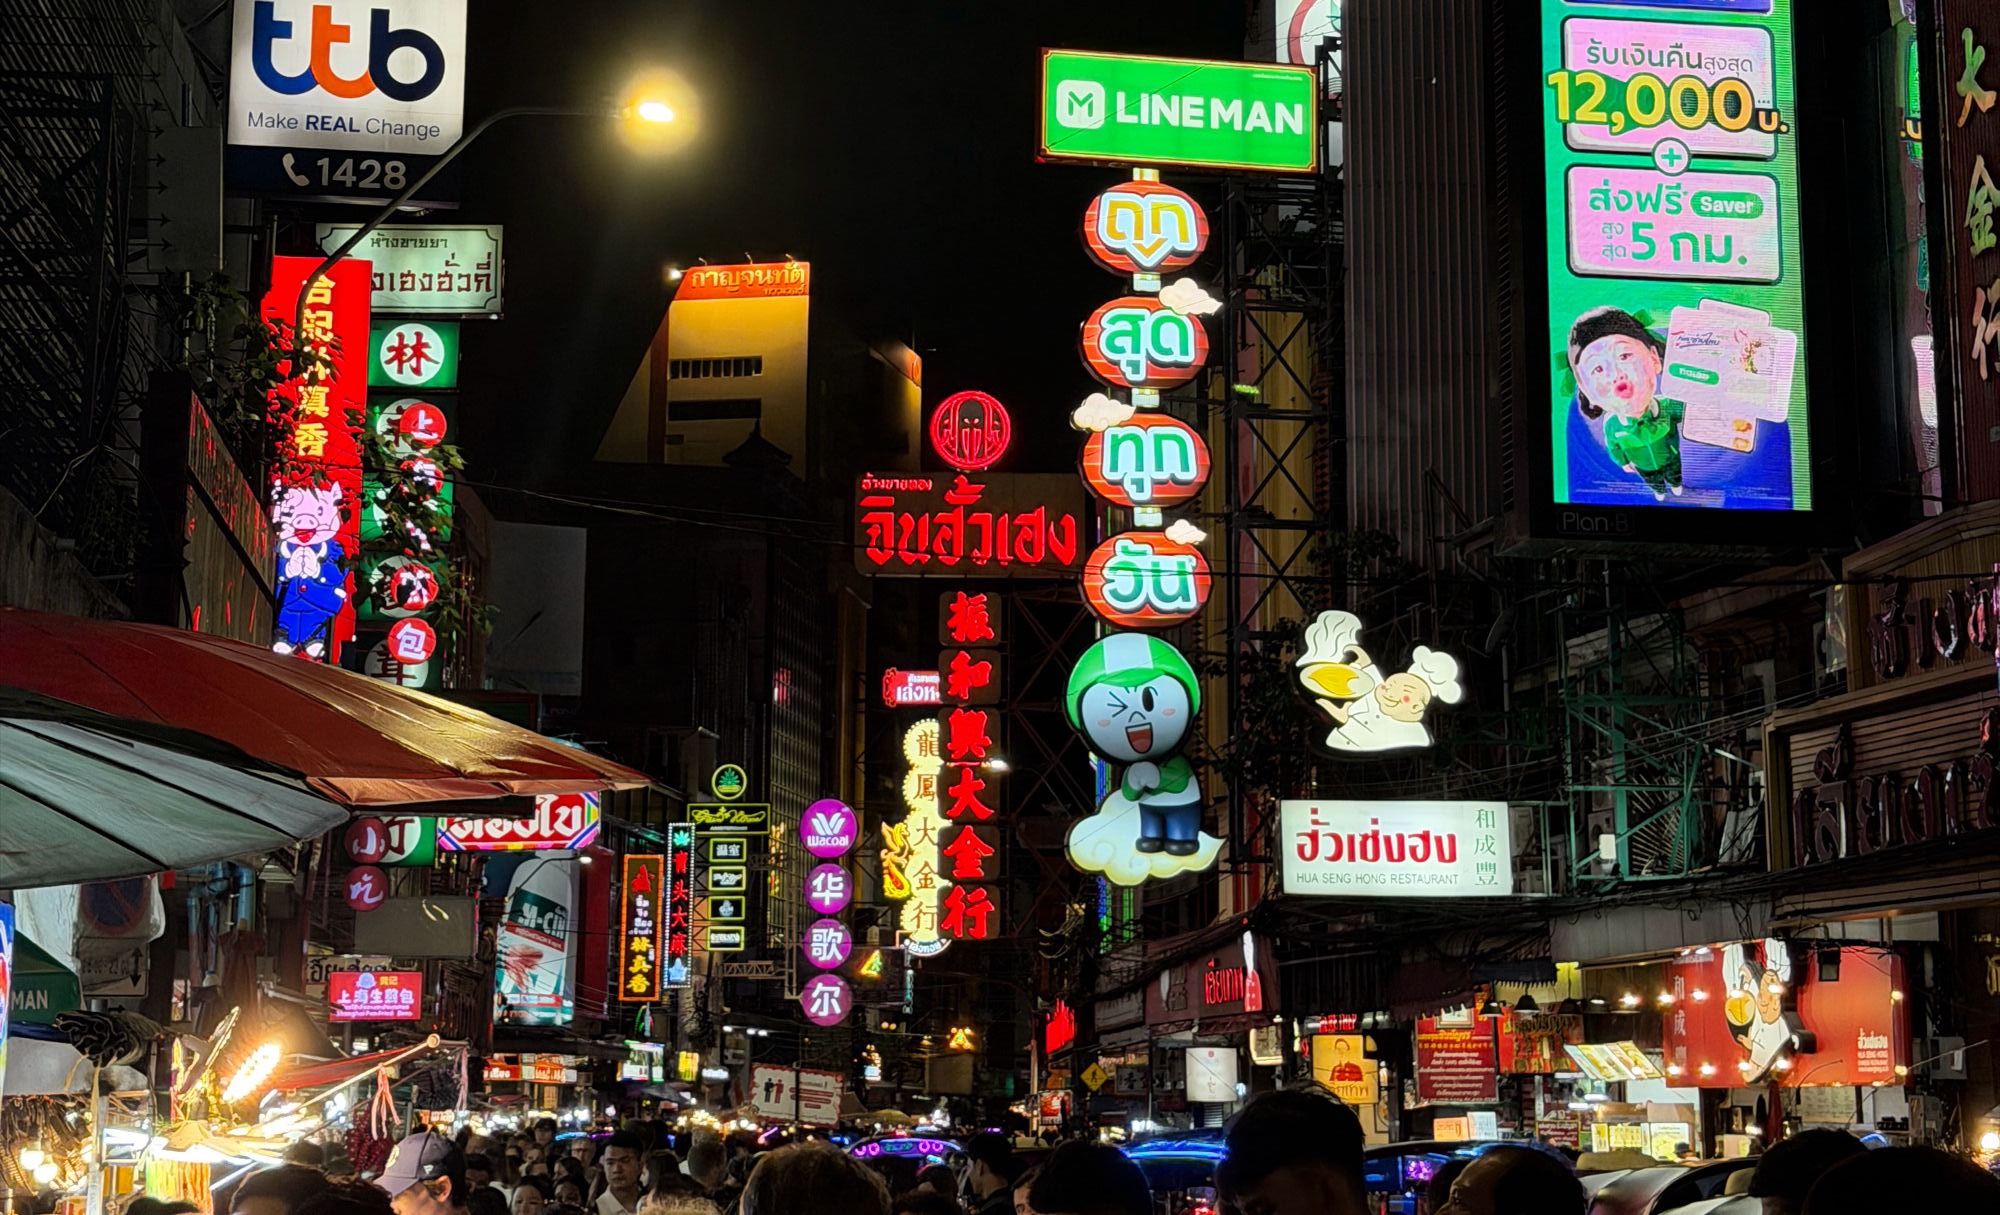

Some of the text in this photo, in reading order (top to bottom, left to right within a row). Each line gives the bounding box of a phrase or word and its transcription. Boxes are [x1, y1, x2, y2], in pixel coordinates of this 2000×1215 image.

[251, 1, 446, 102] ttb
[247, 111, 441, 140] Make REAL Change
[1116, 91, 1204, 128] LINE
[1210, 98, 1303, 135] MAN
[316, 157, 407, 190] 1428
[1700, 197, 1753, 215] Saver
[371, 232, 449, 249] ห้างขายยา
[1632, 221, 1748, 265] 5 กม.
[384, 331, 440, 376] 林
[1105, 313, 1189, 375] สุด
[1109, 433, 1190, 493] ทุก
[1107, 544, 1191, 603] วัน
[807, 834, 849, 848] Wacoal
[1296, 807, 1458, 864] ฮั่วเซ่งฮง
[1296, 873, 1459, 885] HUA SENG HONG RESTAURANT
[810, 872, 845, 1017] 华歌尔
[11, 990, 48, 1010] MAN
